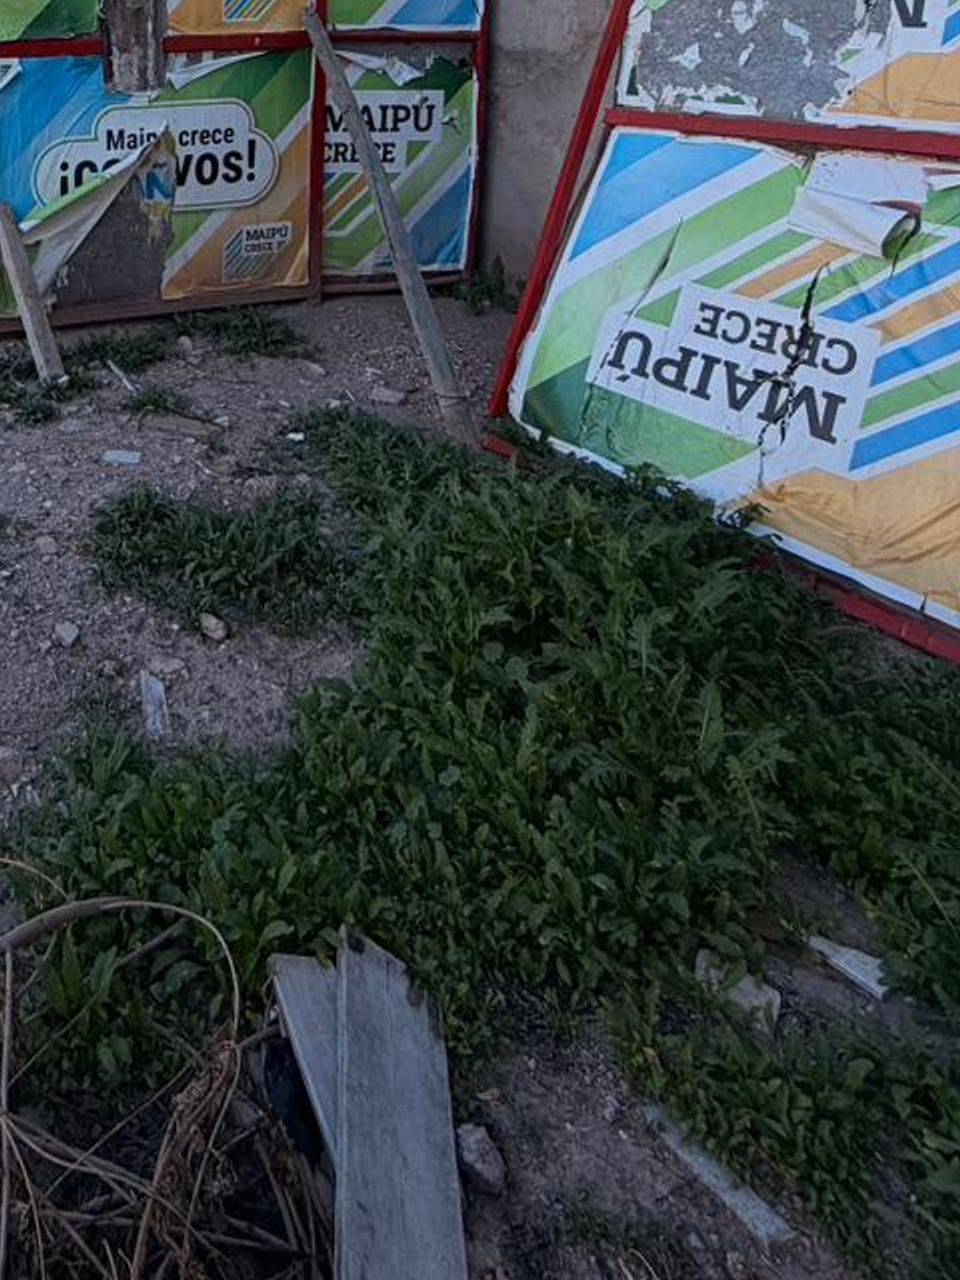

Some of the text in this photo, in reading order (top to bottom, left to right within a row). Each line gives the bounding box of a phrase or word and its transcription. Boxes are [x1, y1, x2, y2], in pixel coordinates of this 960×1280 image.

[106, 127, 235, 151] Mai crece
[175, 139, 257, 187] vos!
[323, 142, 396, 163] CREE
[693, 302, 858, 375] CRECE
[607, 330, 847, 445] MAIPÚ
